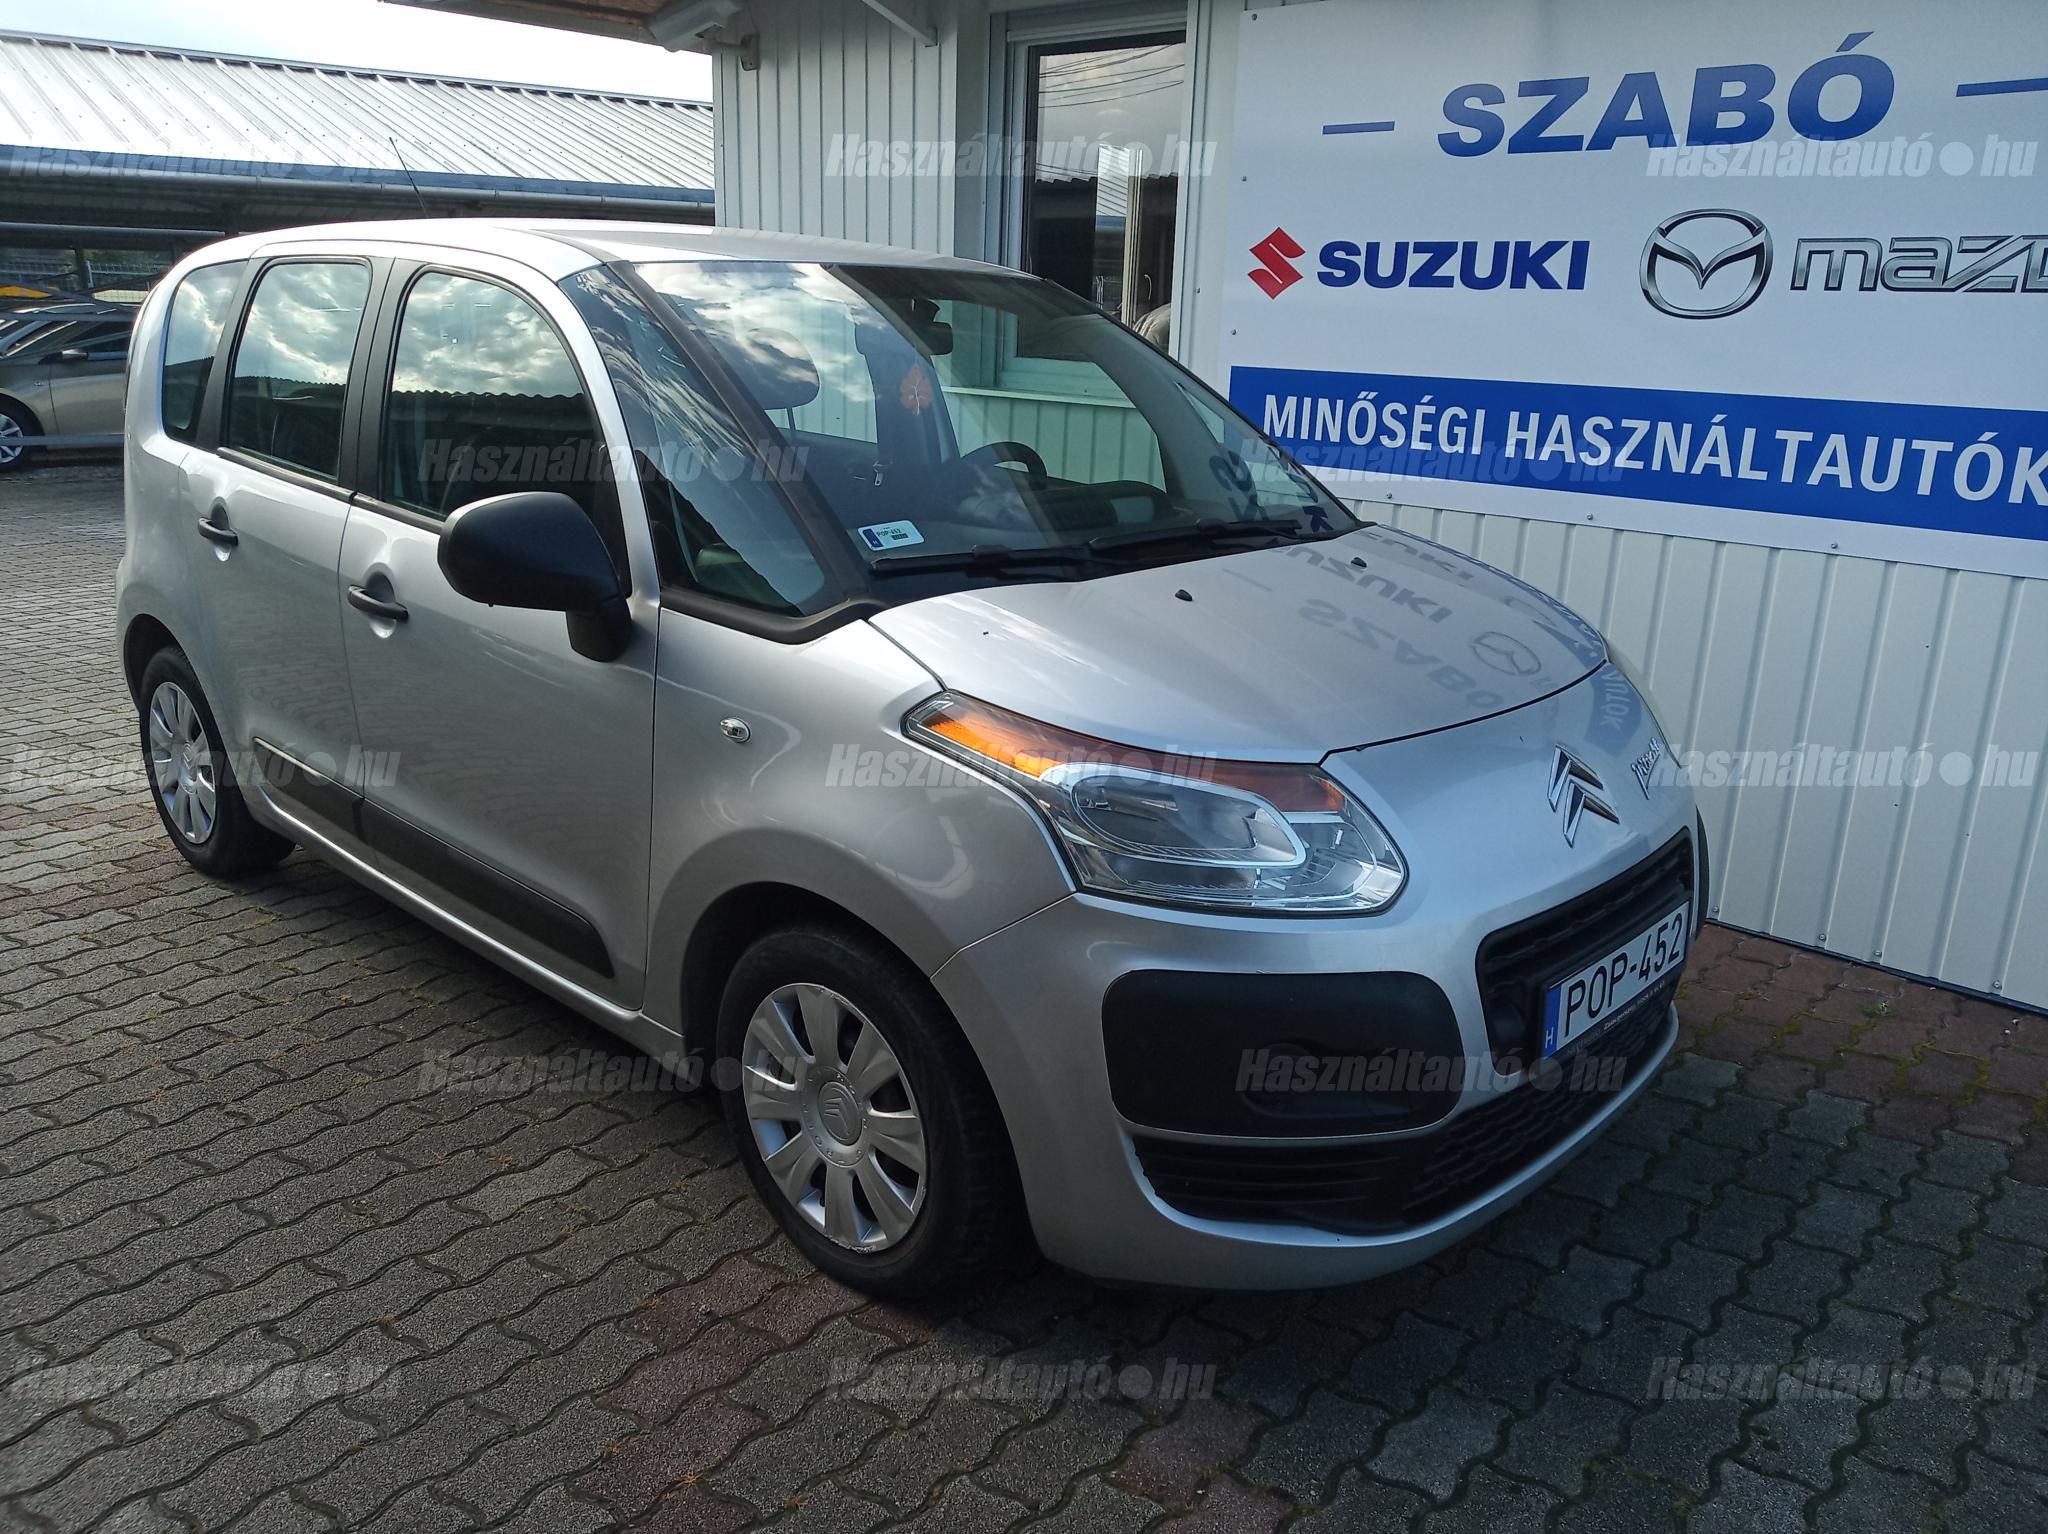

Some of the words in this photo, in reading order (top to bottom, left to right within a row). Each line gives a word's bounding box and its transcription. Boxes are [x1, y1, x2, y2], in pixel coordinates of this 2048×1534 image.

[1437, 31, 1895, 157] SZABÓ
[1316, 240, 1590, 290] SUZUKI
[1263, 390, 1486, 456] MINŐSÉGI
[1504, 411, 2048, 507] HASZNÁLTAUTÓK
[1564, 913, 1683, 1038] POP-452
[1545, 1026, 1555, 1049] H
